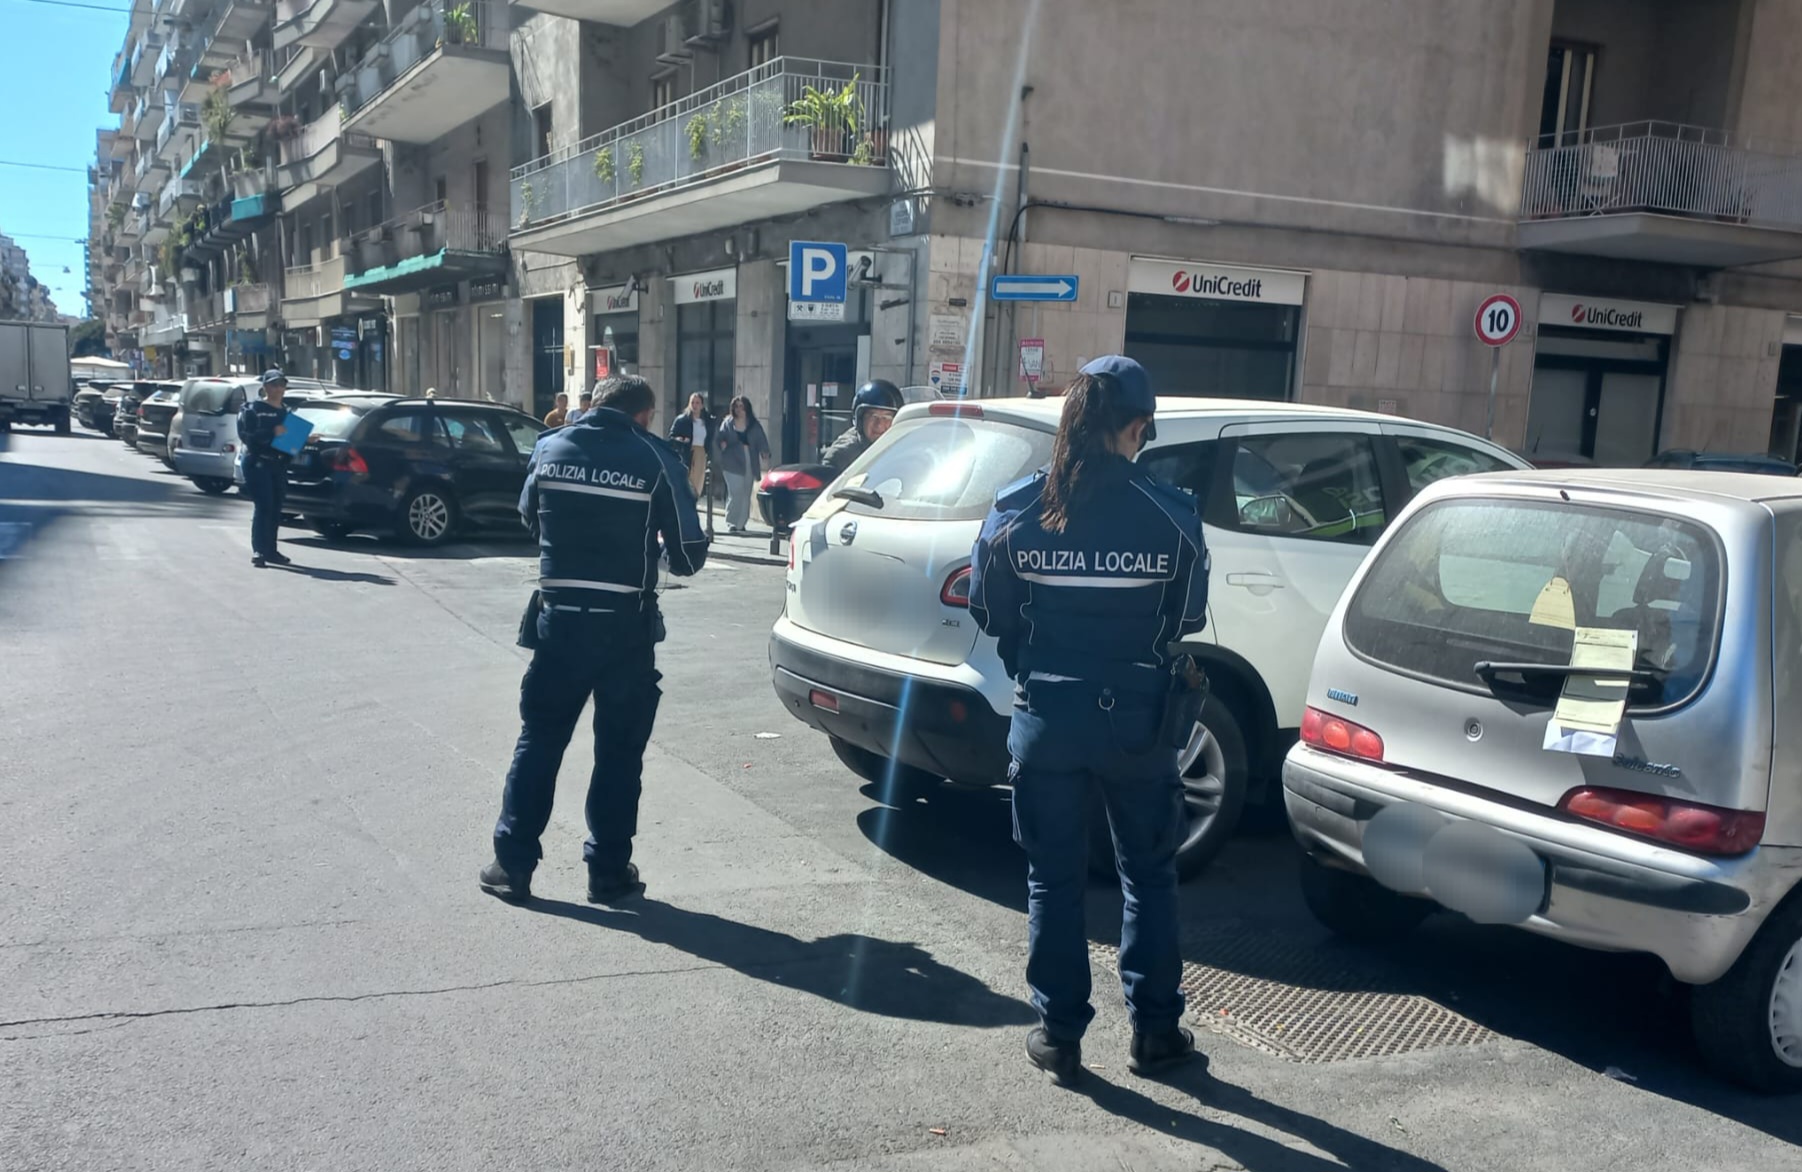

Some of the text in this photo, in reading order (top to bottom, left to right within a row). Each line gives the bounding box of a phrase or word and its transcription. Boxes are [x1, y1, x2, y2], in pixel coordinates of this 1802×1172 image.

[802, 248, 836, 296] P
[699, 279, 724, 298] UniCredit
[1192, 273, 1262, 298] UniCredit
[1488, 308, 1509, 333] 10
[1587, 306, 1644, 328] UniCredit
[541, 463, 647, 490] POLIZIA LOCALE
[1016, 549, 1170, 574] POLIZIA LOCALE
